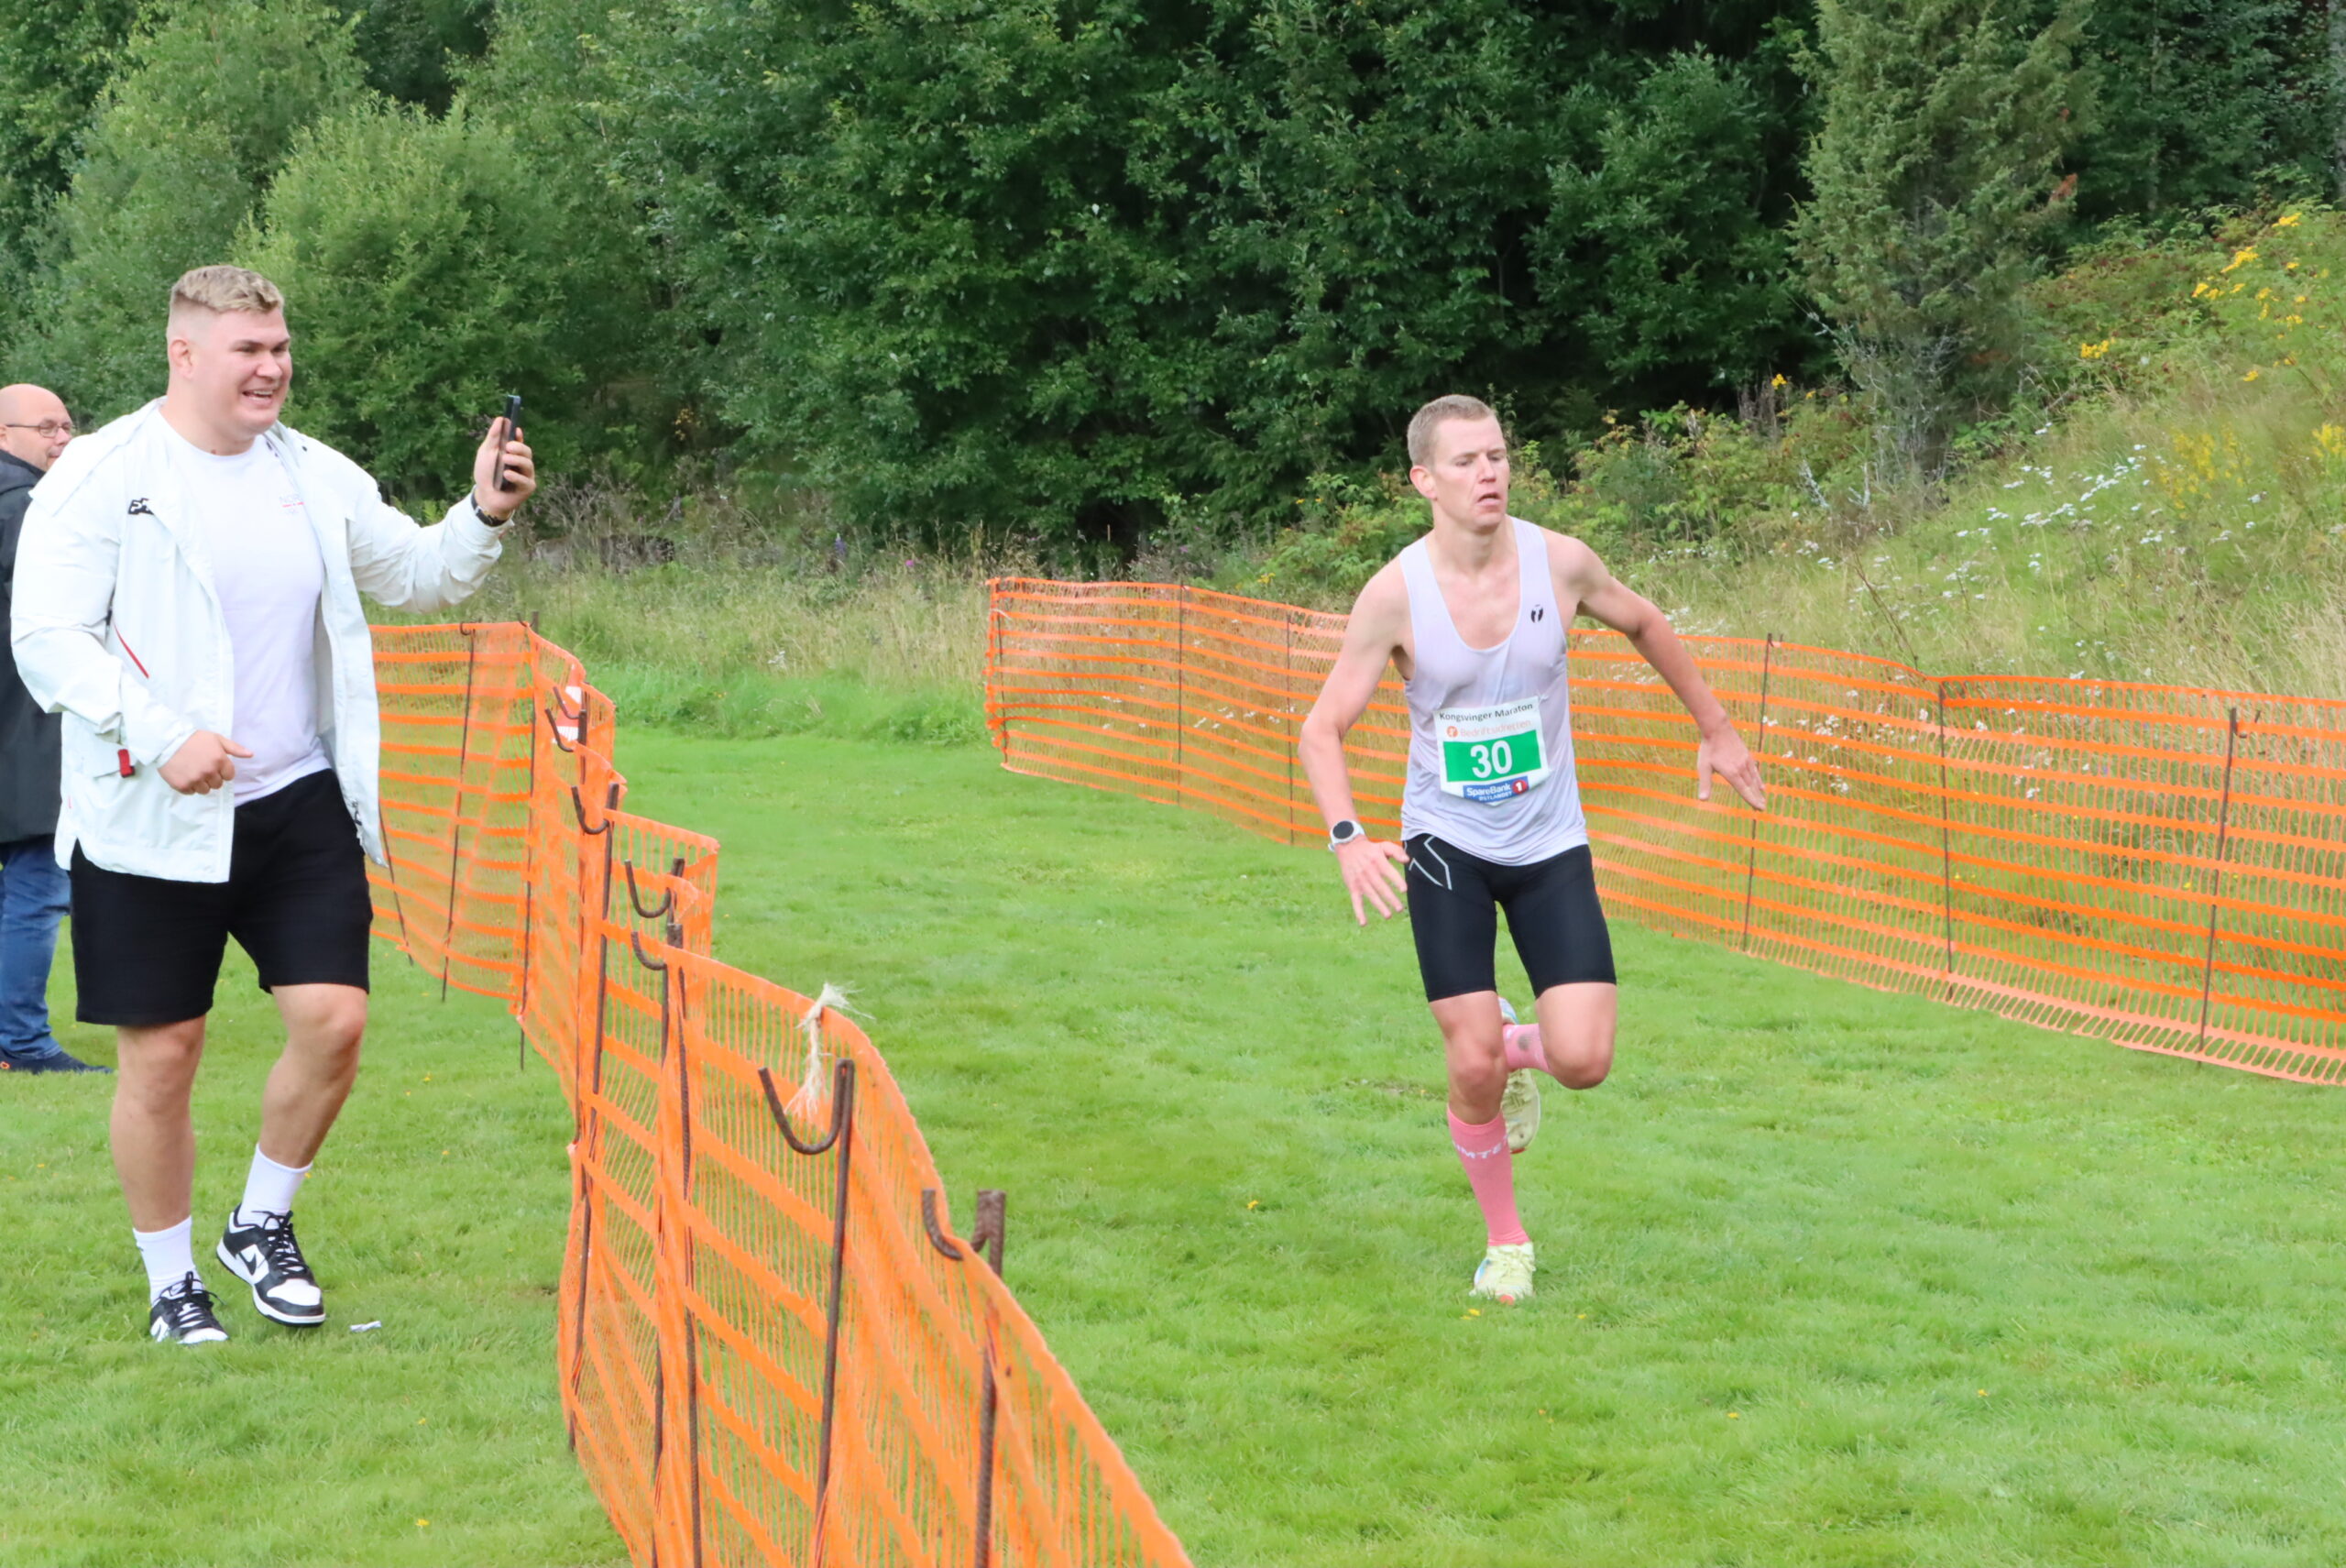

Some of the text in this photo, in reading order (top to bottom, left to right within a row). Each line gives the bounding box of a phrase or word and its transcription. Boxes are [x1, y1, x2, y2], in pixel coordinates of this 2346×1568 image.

[1439, 703, 1533, 722] Kongsvinger Maraton
[1470, 740, 1512, 778] 30
[1466, 783, 1511, 797] SpareBank
